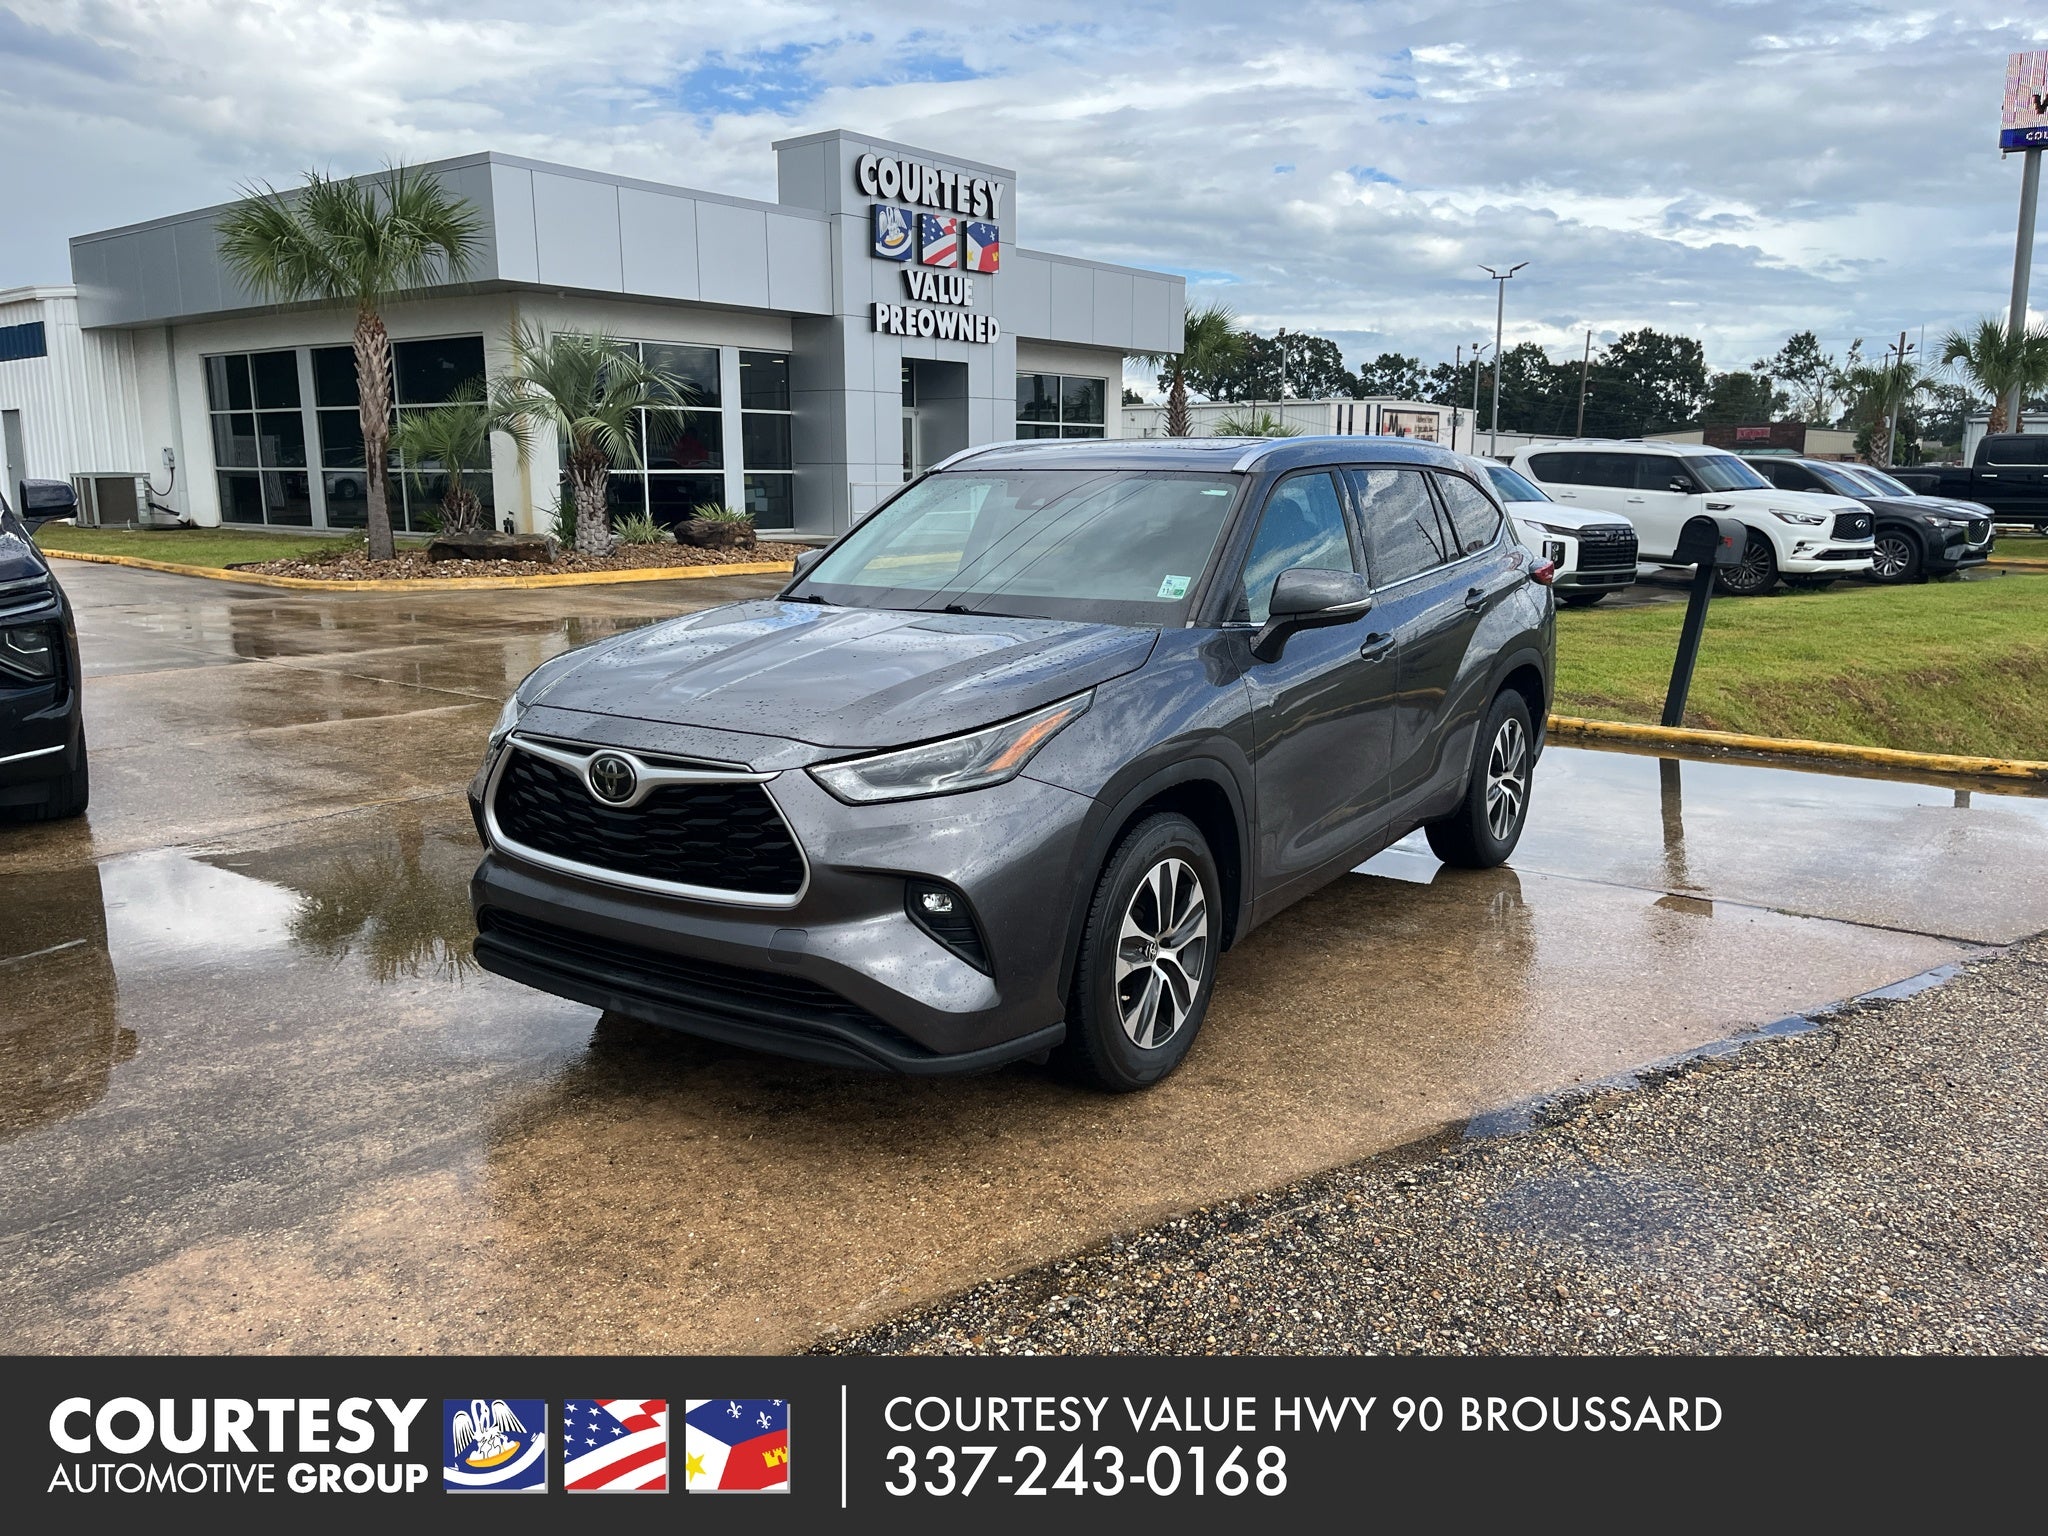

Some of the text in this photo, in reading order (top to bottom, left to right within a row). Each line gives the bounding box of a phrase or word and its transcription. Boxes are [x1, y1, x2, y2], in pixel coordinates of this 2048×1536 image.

[856, 152, 1005, 219] COURTESY
[902, 269, 973, 306] VALUE
[871, 302, 1000, 344] PREOWNED
